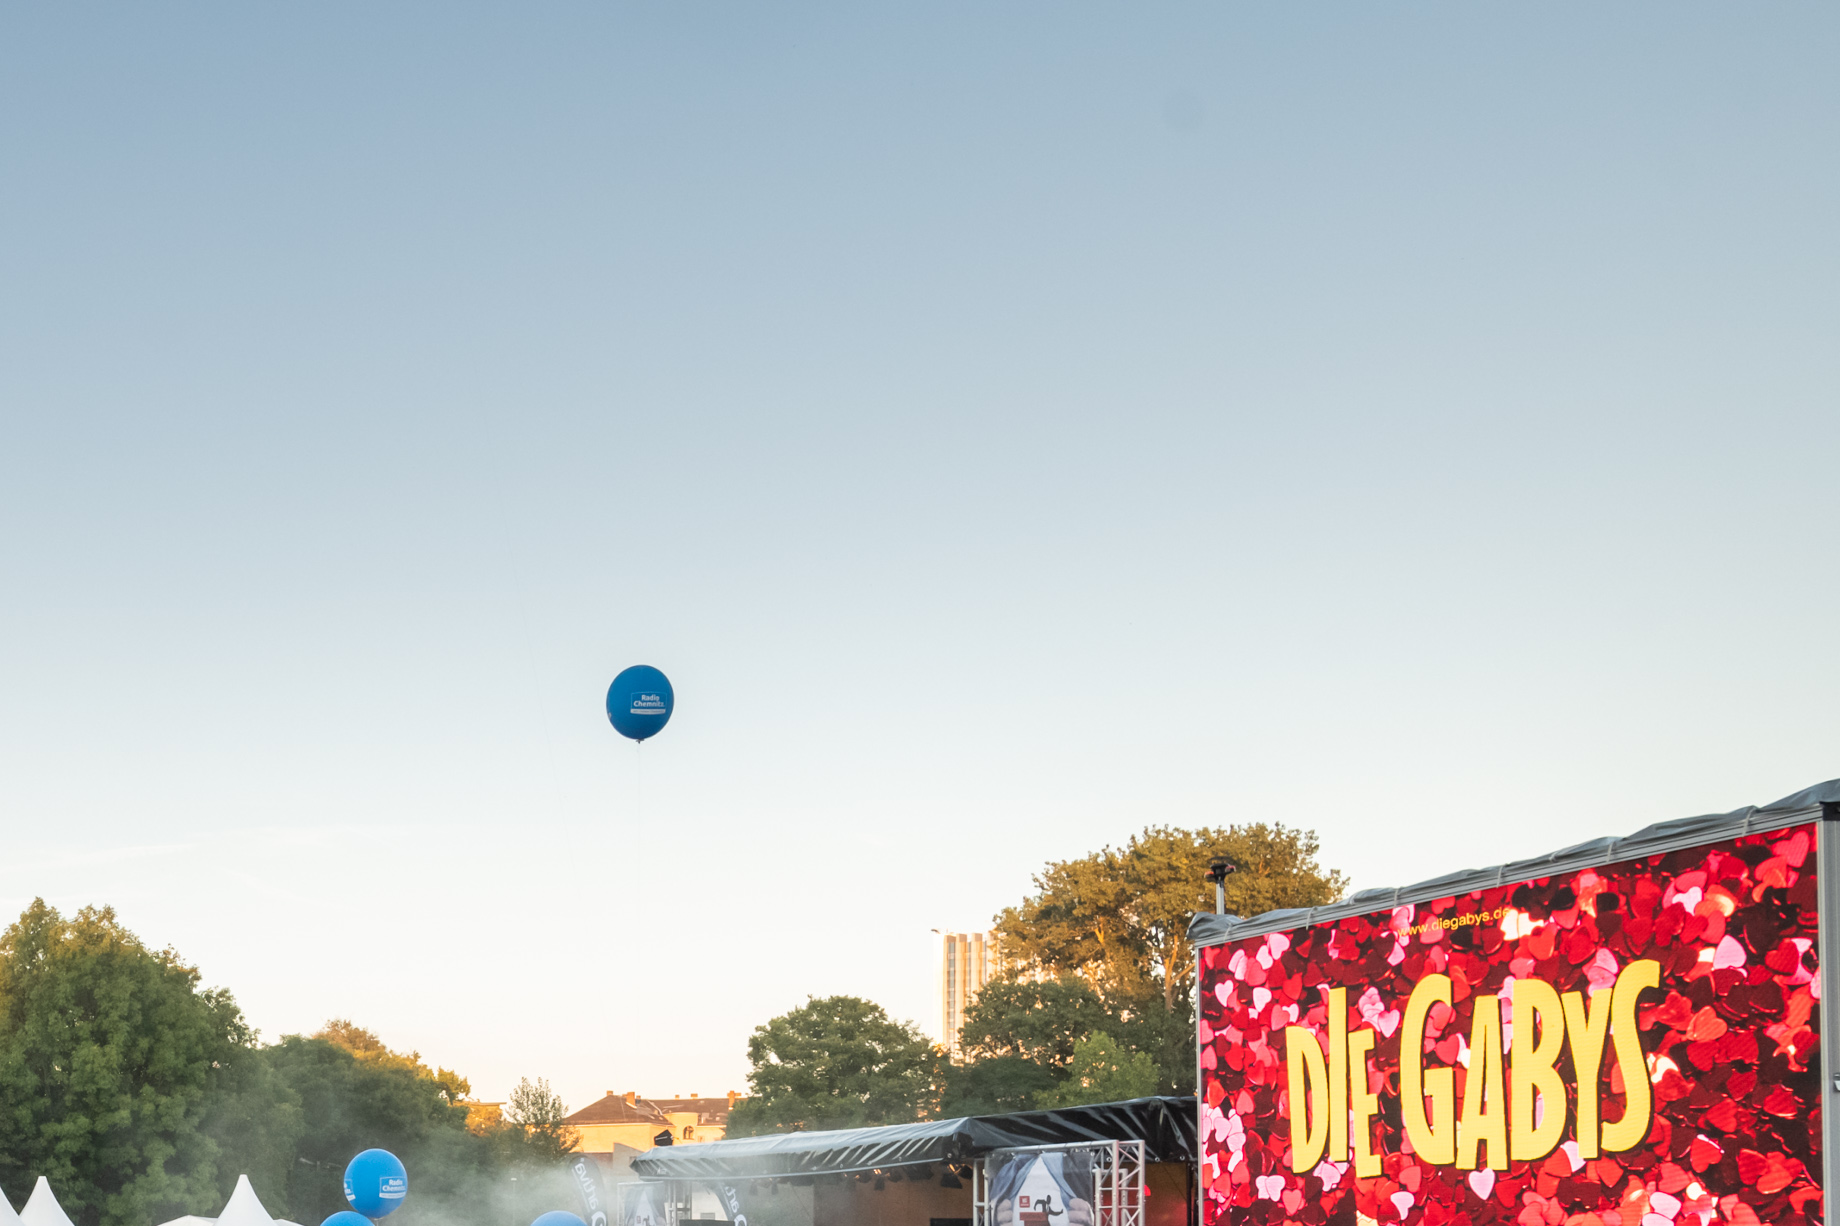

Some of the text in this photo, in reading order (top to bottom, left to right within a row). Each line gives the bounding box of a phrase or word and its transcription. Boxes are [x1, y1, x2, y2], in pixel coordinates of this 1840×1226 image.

[1398, 906, 1510, 937] www.diegabys.de
[1285, 958, 1660, 1178] DIE GABYS
